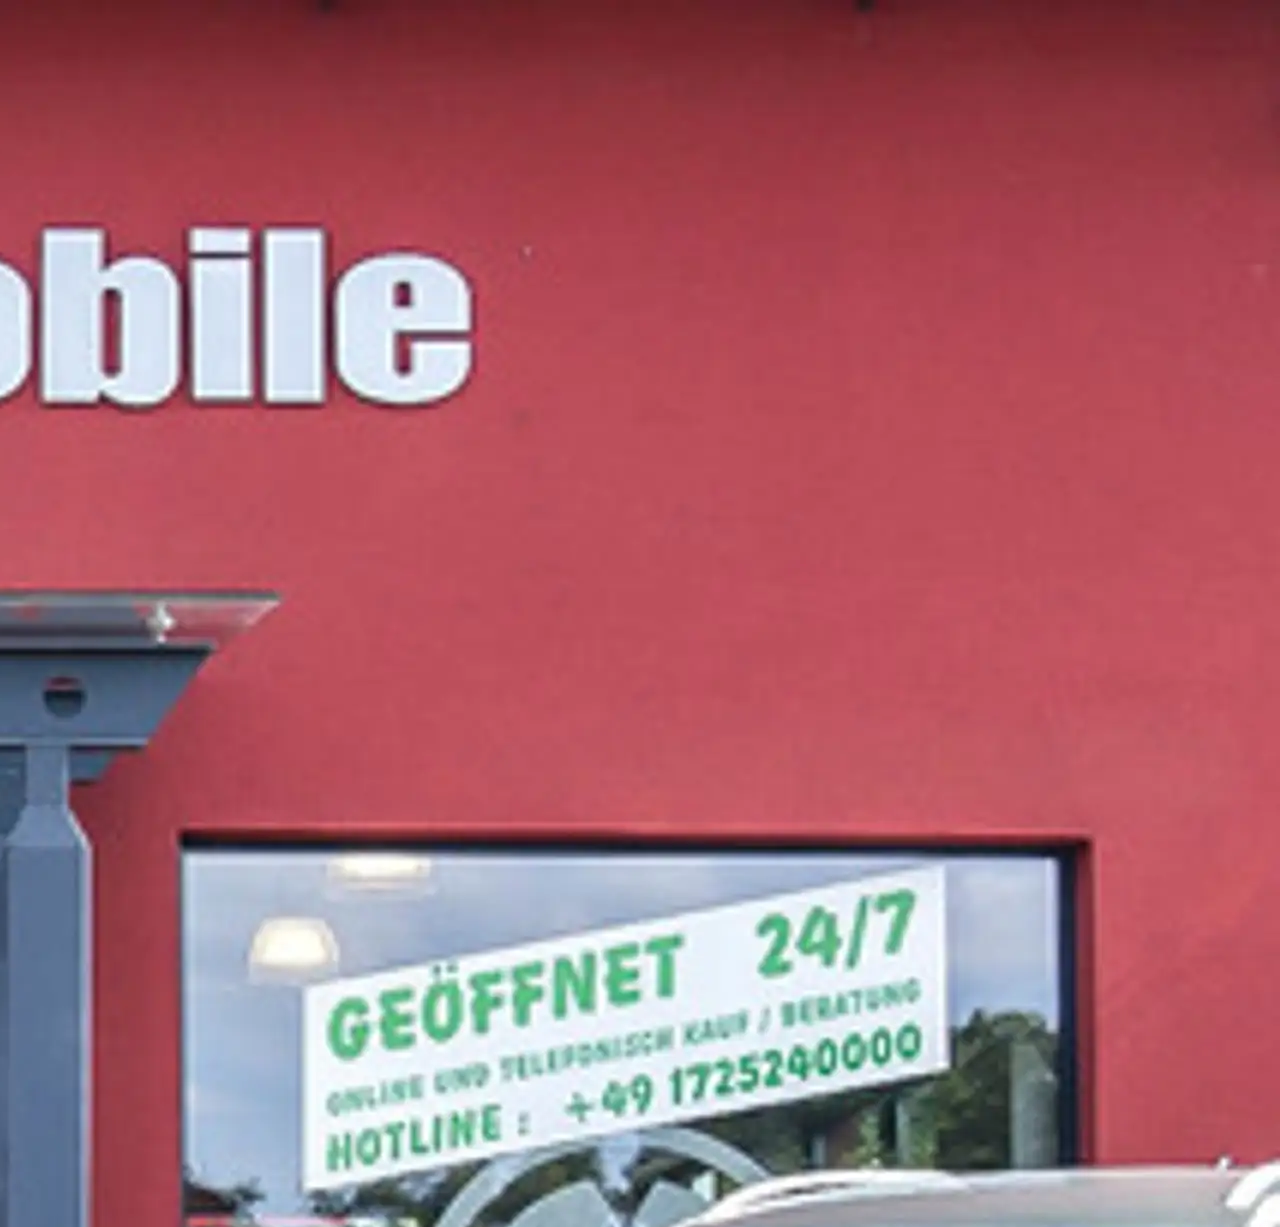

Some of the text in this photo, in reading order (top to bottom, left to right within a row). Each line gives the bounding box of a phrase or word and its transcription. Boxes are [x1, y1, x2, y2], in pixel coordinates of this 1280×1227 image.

[325, 1073, 424, 1118] ONLINE
[434, 1061, 490, 1094] UND
[499, 1025, 675, 1082] TELEFONISCH
[683, 1010, 749, 1046] KAUF
[781, 977, 921, 1028] BERATUNG
[327, 888, 918, 1060] GEÖFFNET 24/7
[326, 1104, 503, 1173] HOTLINE
[564, 1072, 654, 1123] +49
[668, 1022, 922, 1105] 1725240000
